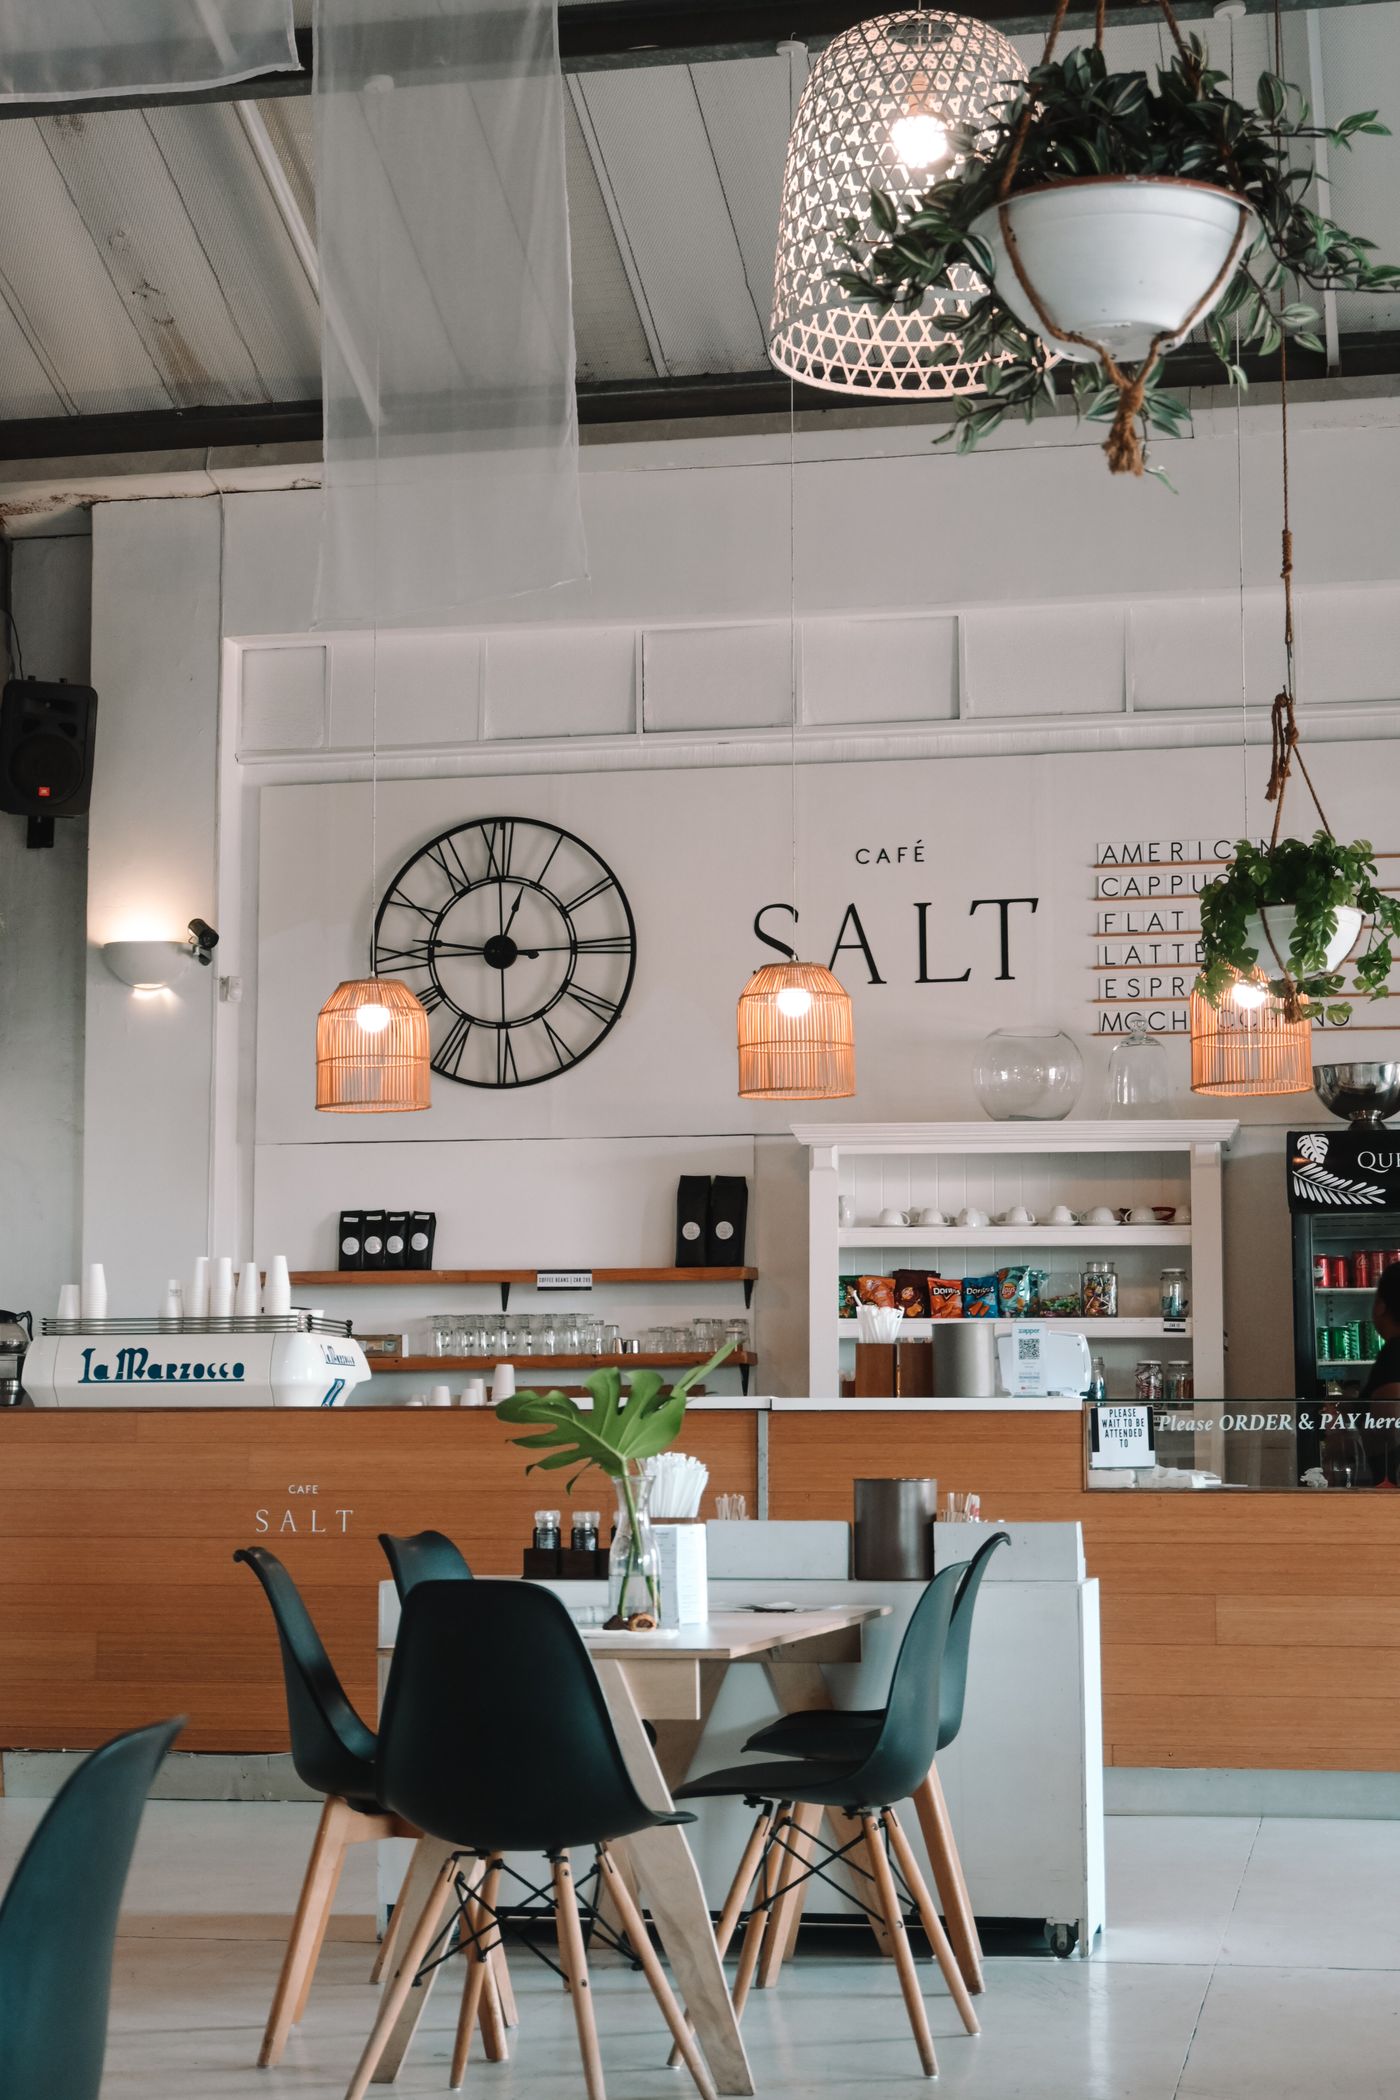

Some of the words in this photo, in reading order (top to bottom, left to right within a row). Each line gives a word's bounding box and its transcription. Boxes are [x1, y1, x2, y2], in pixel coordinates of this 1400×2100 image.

[855, 839, 925, 865] CAFÉ
[1103, 910, 1185, 933] FLAT
[753, 897, 1039, 984] SALT
[1104, 943, 1206, 966] LATTE
[1105, 976, 1186, 999] ESPR
[1357, 1150, 1400, 1174] QU
[79, 1348, 110, 1383] La
[1101, 1418, 1120, 1428] WAIT
[1124, 1418, 1133, 1428] TO
[1135, 1418, 1145, 1427] BE
[1108, 1408, 1137, 1418] PLEASE
[1157, 1414, 1214, 1432] Please
[1218, 1413, 1293, 1431] ORDER
[1298, 1412, 1315, 1430] &
[1319, 1412, 1362, 1430] PAY
[1364, 1412, 1400, 1430] here
[1104, 1428, 1143, 1438] ATTENDED
[1119, 1438, 1129, 1448] TO
[288, 1484, 319, 1495] CAFE
[255, 1508, 354, 1533] SALT
